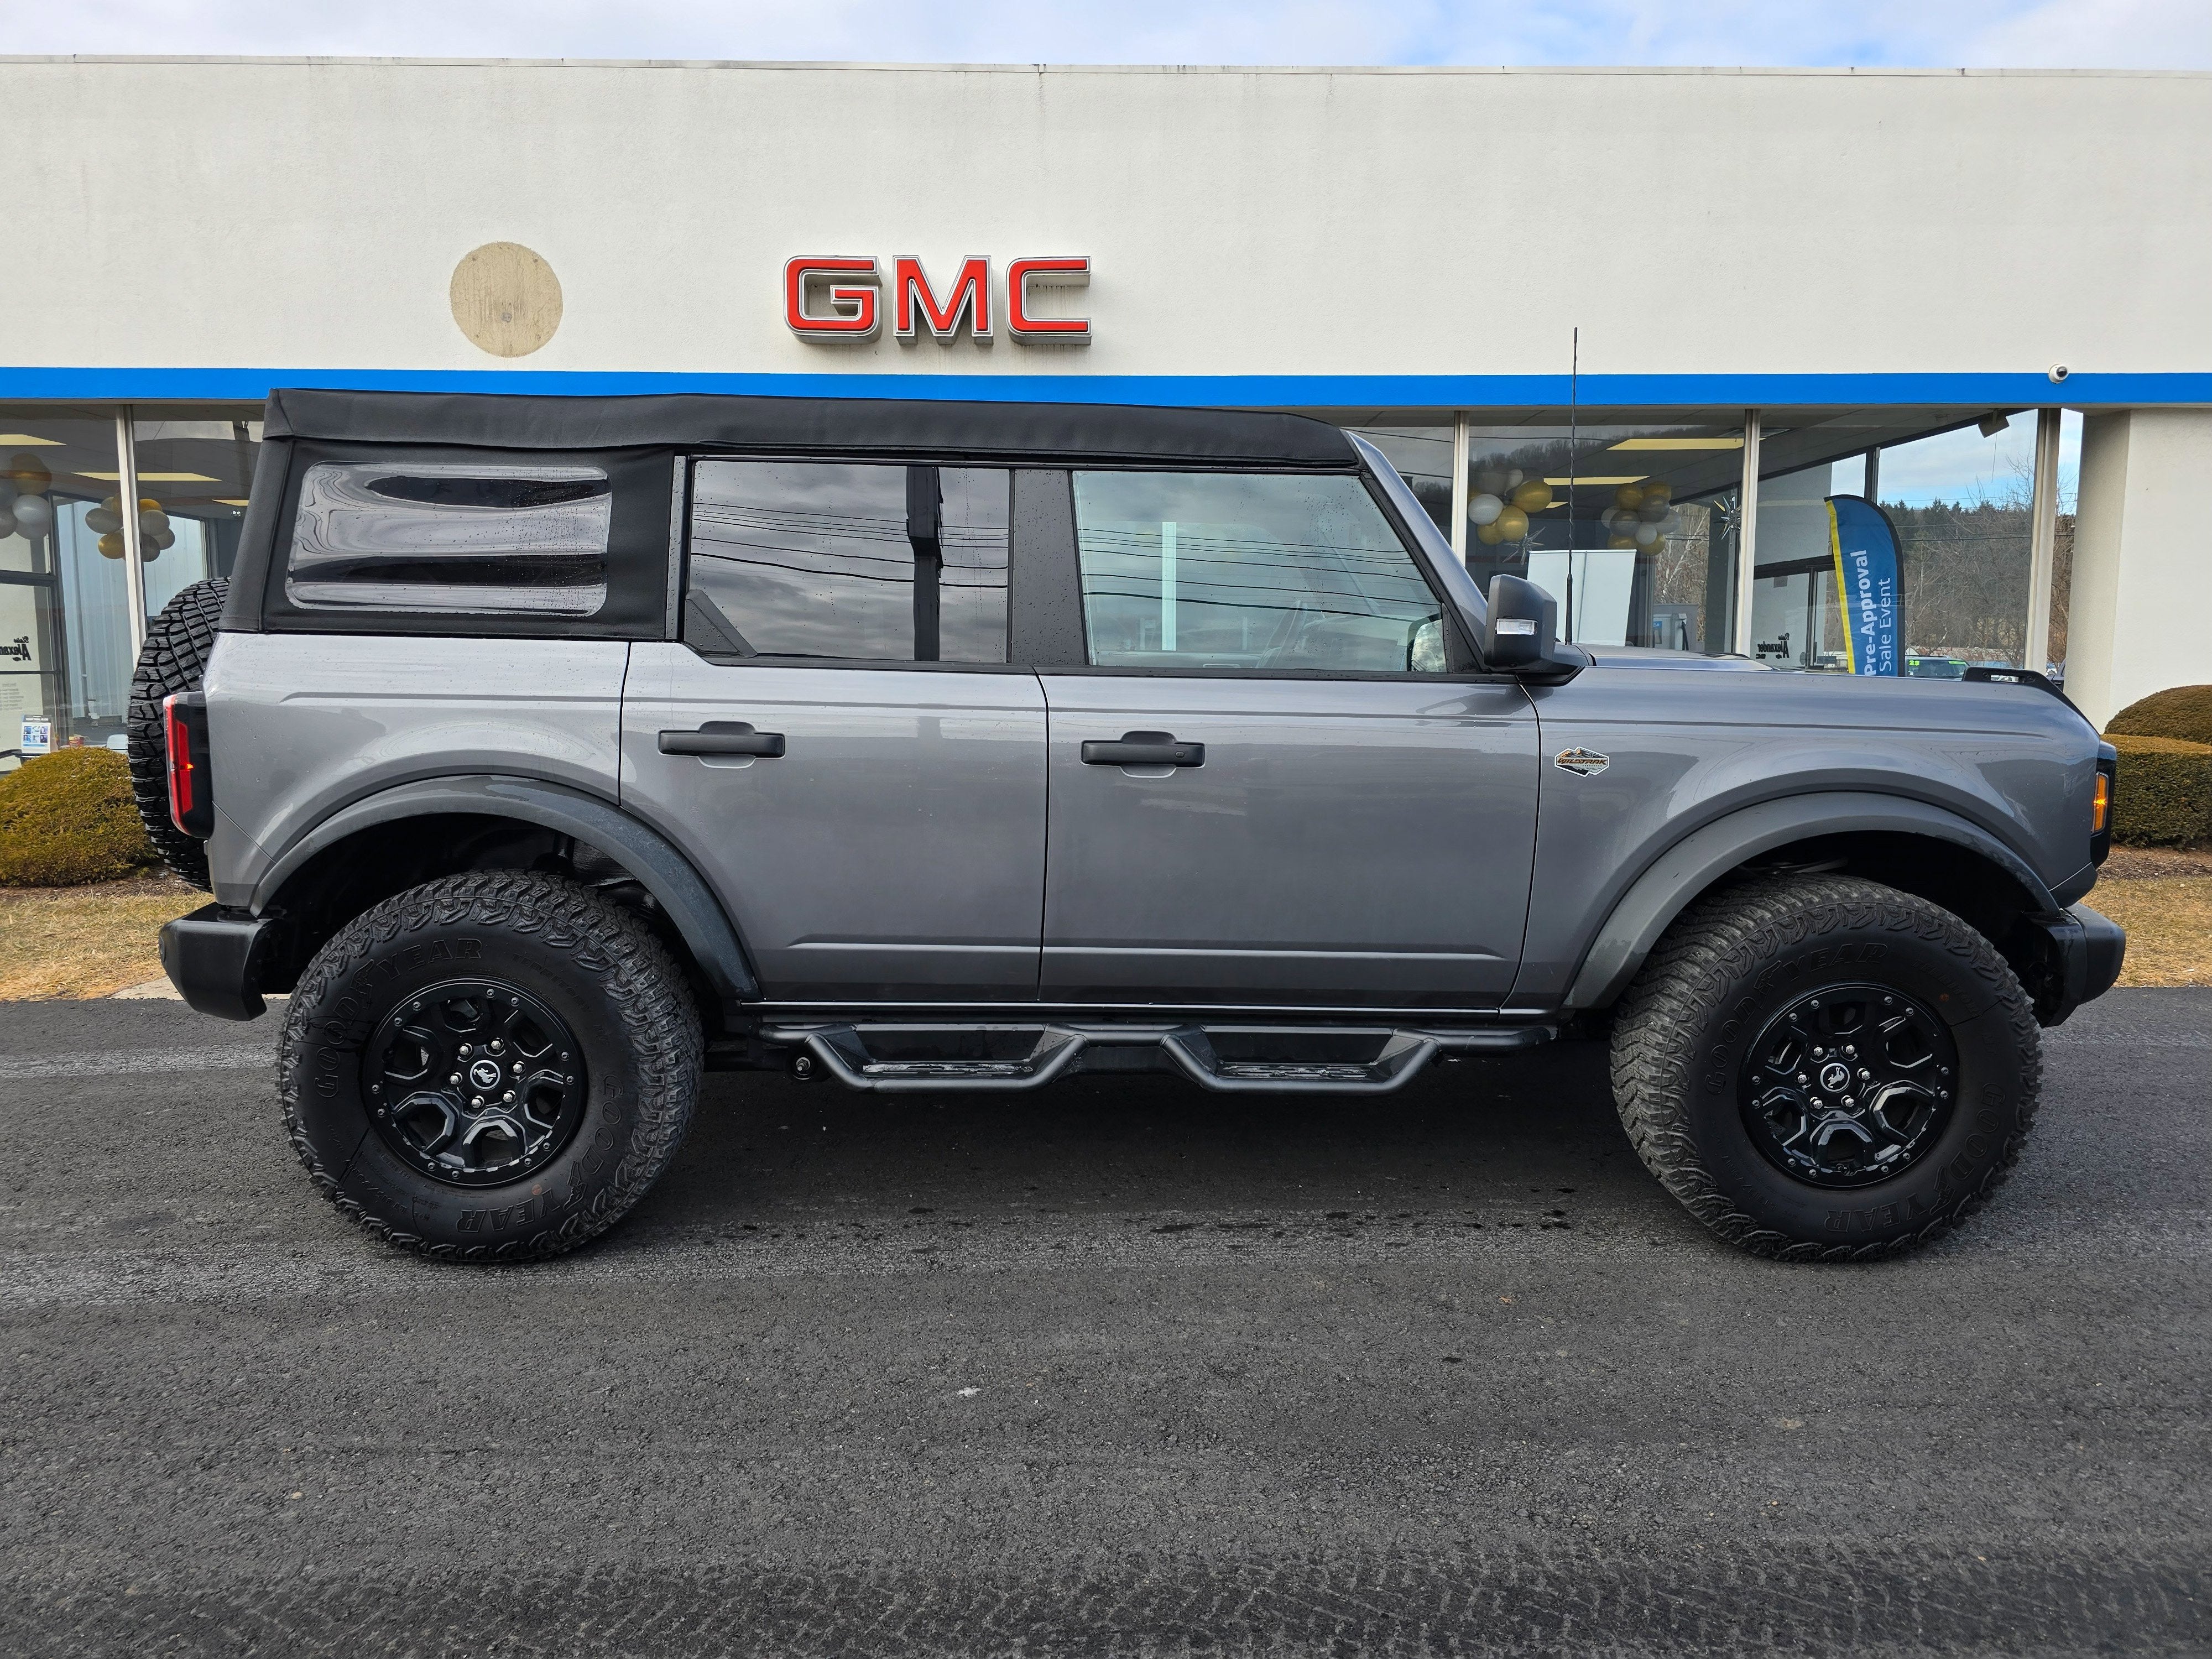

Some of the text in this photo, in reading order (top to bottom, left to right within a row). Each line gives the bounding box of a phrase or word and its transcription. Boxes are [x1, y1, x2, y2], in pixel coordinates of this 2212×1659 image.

[783, 255, 1093, 342] GMC
[1850, 550, 1877, 676] Pre-Approval
[1878, 577, 1891, 672] Sale Event
